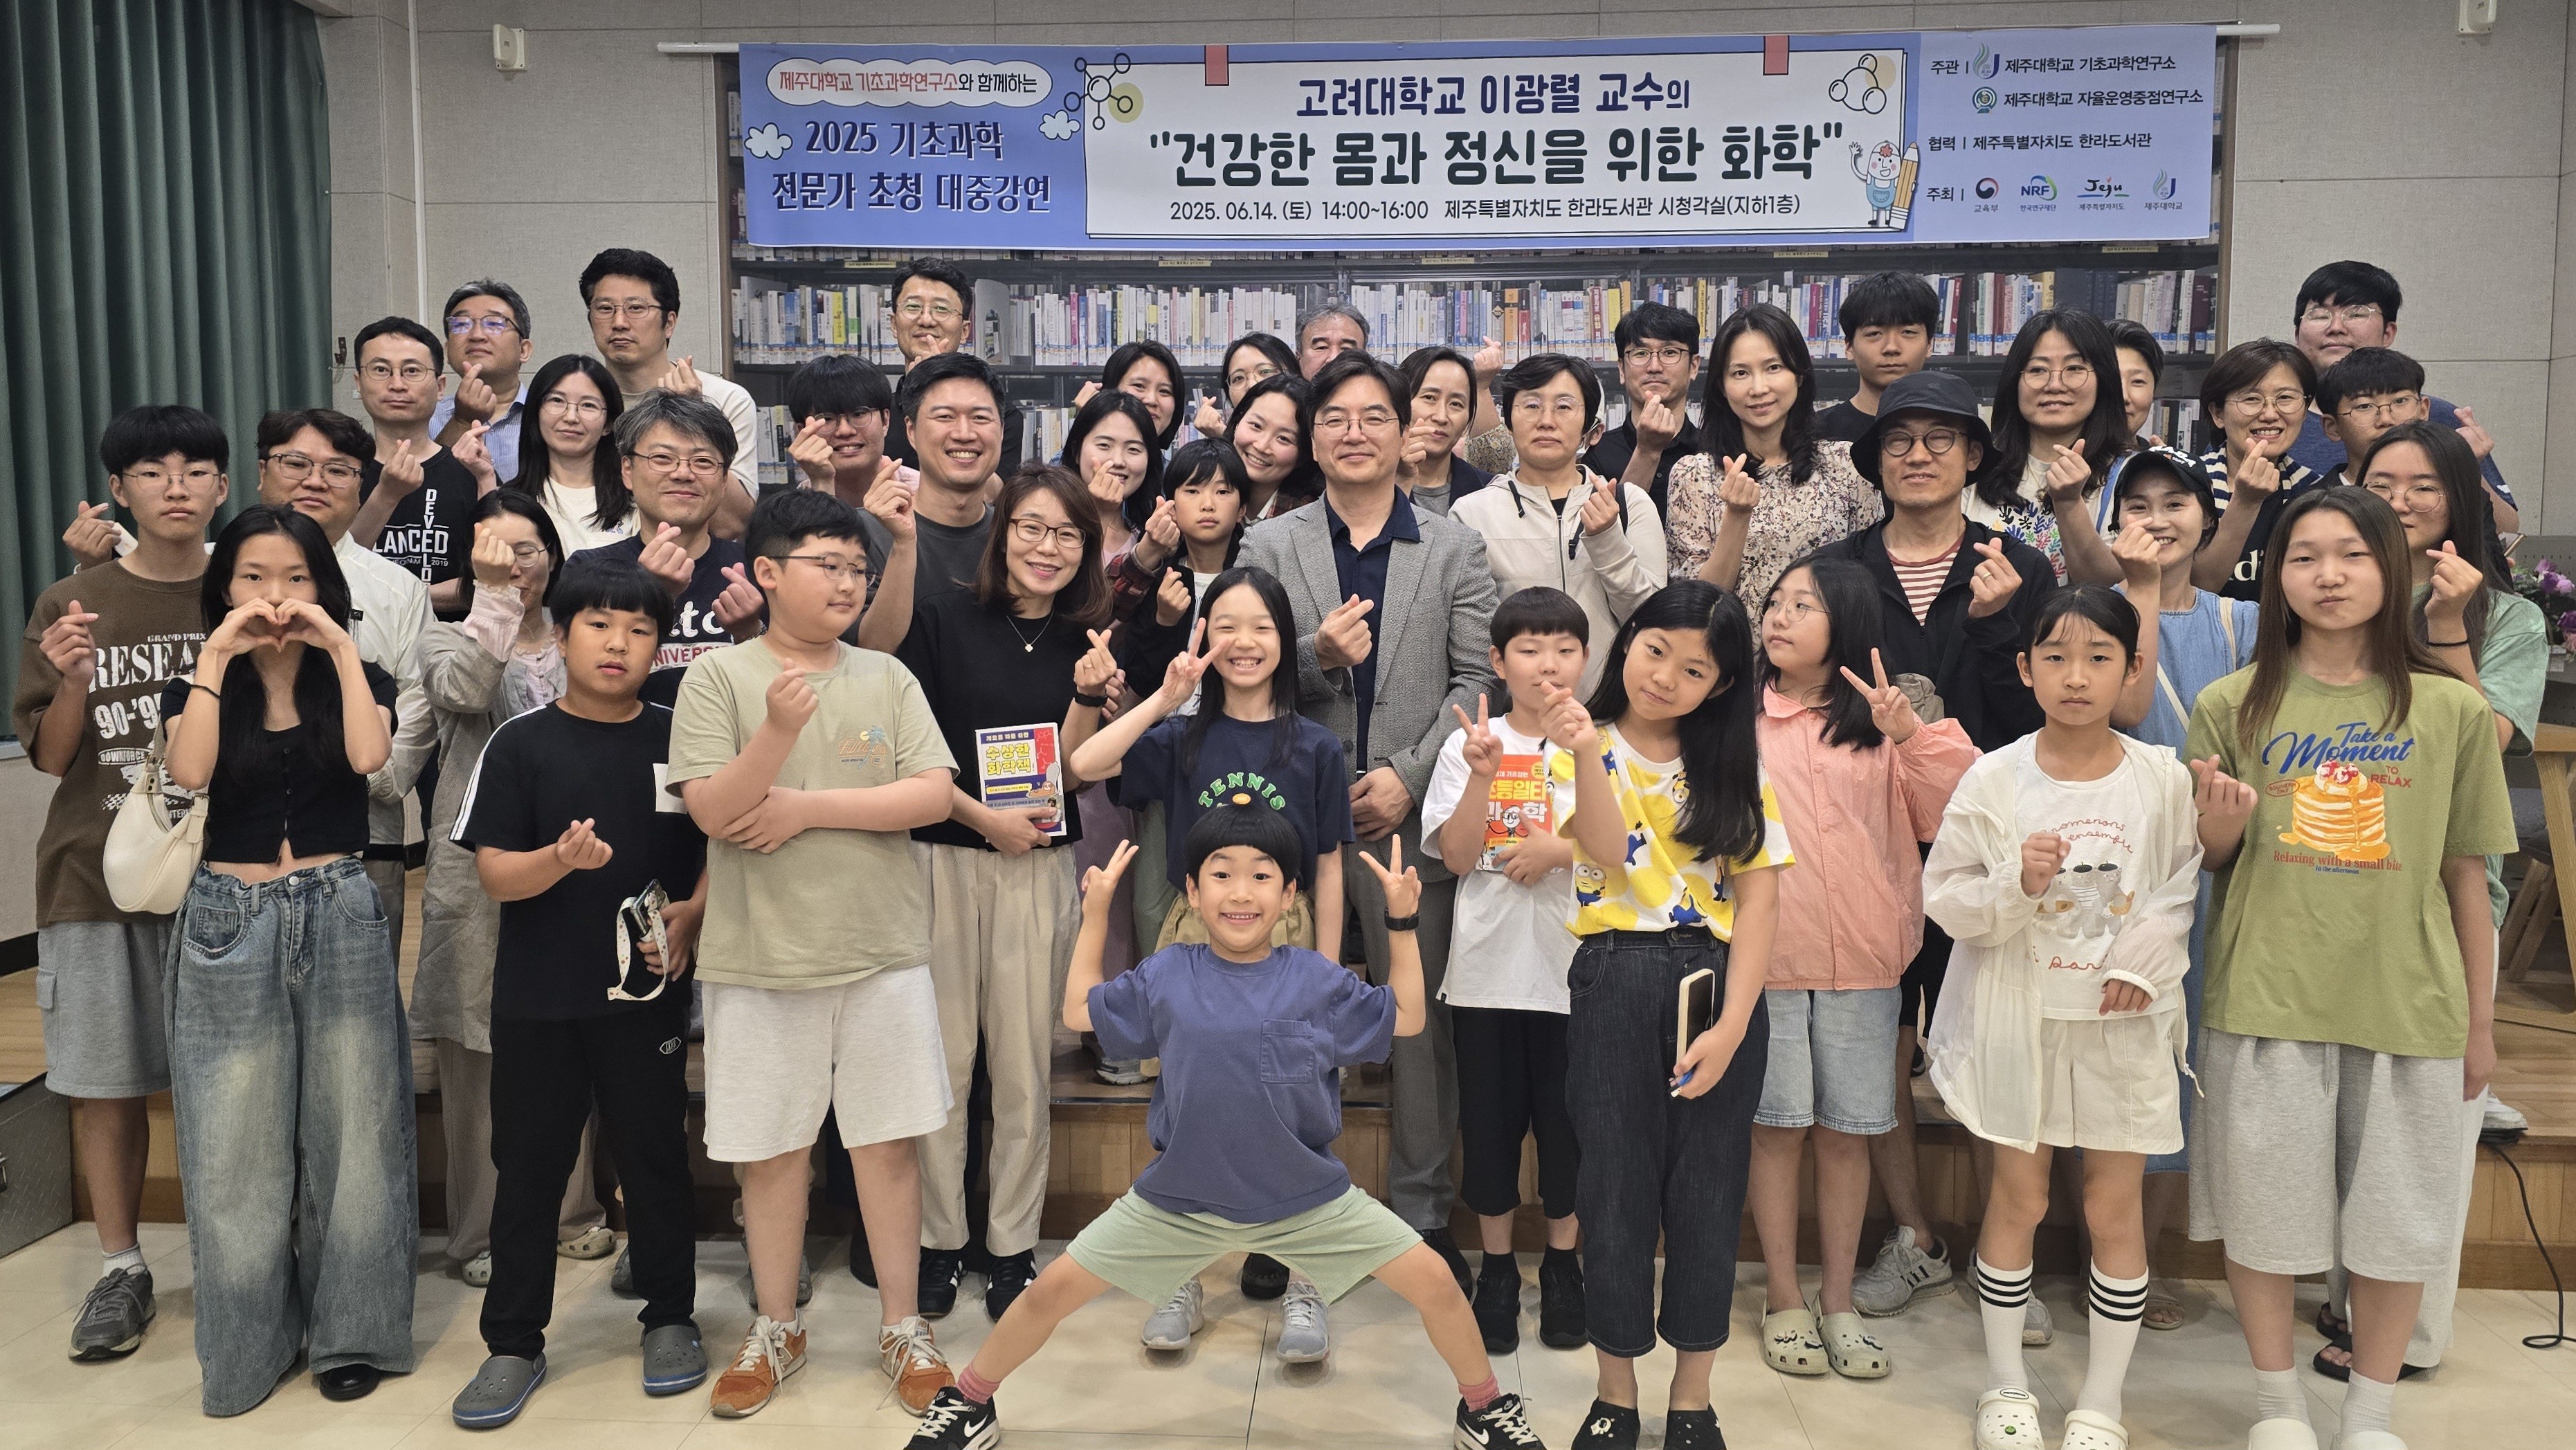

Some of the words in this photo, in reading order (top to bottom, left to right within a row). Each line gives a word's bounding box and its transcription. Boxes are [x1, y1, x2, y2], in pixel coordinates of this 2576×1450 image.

[1930, 60, 1959, 75] 주관
[2004, 57, 2075, 73] 제주대학교
[2079, 55, 2177, 72] 기초과학연구소
[779, 71, 853, 92] 제주대학교
[855, 72, 974, 93] 기초과학연구소와
[978, 73, 1037, 94] 함께하는
[1296, 75, 1467, 117] 고려대학교
[1480, 73, 1581, 116] 이광렬
[1595, 72, 1690, 112] 교수의
[2004, 91, 2074, 108] 제주대학교
[2077, 88, 2204, 107] 자율운영중점연구소
[805, 120, 879, 154] 2025
[889, 120, 1005, 162] 기초과학
[1928, 136, 1956, 152] 협력
[1972, 133, 2074, 151] 제주특별자치도
[2078, 132, 2152, 149] 한라도서관
[1150, 130, 1316, 187] "건강한
[1332, 132, 1428, 186] 몸과
[1444, 129, 1588, 185] 정신을
[1607, 127, 1705, 182] 위한
[1721, 122, 1843, 181] 화학"
[771, 172, 858, 211] 전문가
[868, 172, 924, 212] 초청
[936, 174, 1051, 214] 대중강연
[1926, 186, 1954, 203] 주최
[2021, 185, 2051, 196] NRF
[2084, 178, 2123, 198] Jeju
[1170, 202, 1220, 220] 2025.
[1226, 201, 1278, 220] 06.14.
[1282, 201, 1312, 221] (토)
[1322, 201, 1429, 220] 14:00~16:00
[1444, 198, 1563, 219] 제주특별자치도
[1568, 197, 1653, 218] 한라도서관
[1658, 194, 1801, 217] 시청각실(지하1층)
[1974, 204, 1999, 213] 교육부
[2078, 203, 2125, 211] 제주특별자치도
[2144, 201, 2183, 211] 제주대학교
[372, 529, 449, 554] LANCED
[147, 634, 182, 642] GRAND
[183, 633, 207, 641] PRIX
[89, 642, 206, 694] RESEA
[2336, 722, 2379, 748] Take
[2384, 732, 2396, 742] a
[986, 743, 1030, 761] 수상한
[2262, 732, 2415, 774] Moment
[987, 758, 1031, 776] 화학책
[2386, 765, 2400, 774] TO
[1199, 772, 1286, 810] TENNIS
[2370, 774, 2412, 788] RELAX
[2042, 818, 2125, 834] romenons
[2274, 850, 2315, 867] Relaxing
[2319, 854, 2342, 867] with
[2345, 858, 2352, 867] a
[2354, 858, 2384, 869] small
